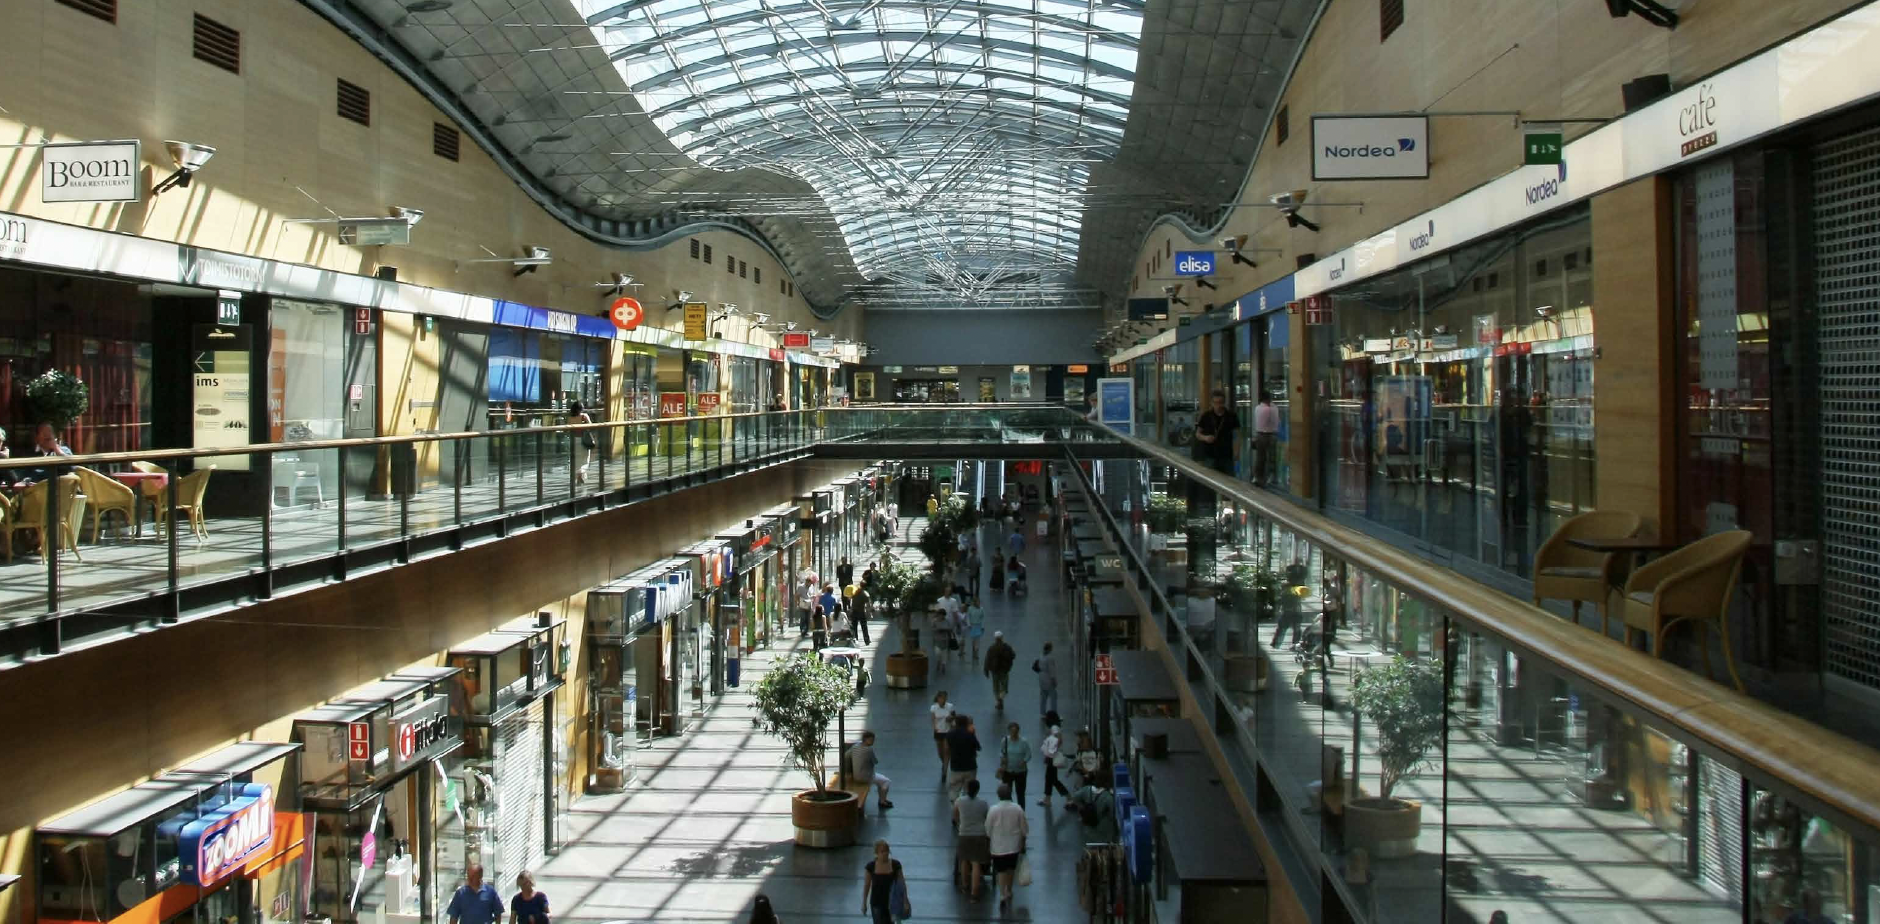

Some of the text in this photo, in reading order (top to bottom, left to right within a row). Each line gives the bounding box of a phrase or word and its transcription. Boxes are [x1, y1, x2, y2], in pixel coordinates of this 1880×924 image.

[1679, 84, 1716, 136] café
[1325, 144, 1395, 158] Nordea
[47, 159, 131, 188] Boom
[88, 179, 130, 187] RESTAURANT
[1525, 177, 1558, 207] Nordea
[1409, 232, 1430, 252] Nordea
[1179, 255, 1211, 272] elisa
[196, 375, 219, 387] ims
[700, 395, 717, 405] ALE
[662, 402, 684, 414] ALE
[1101, 558, 1121, 568] WC
